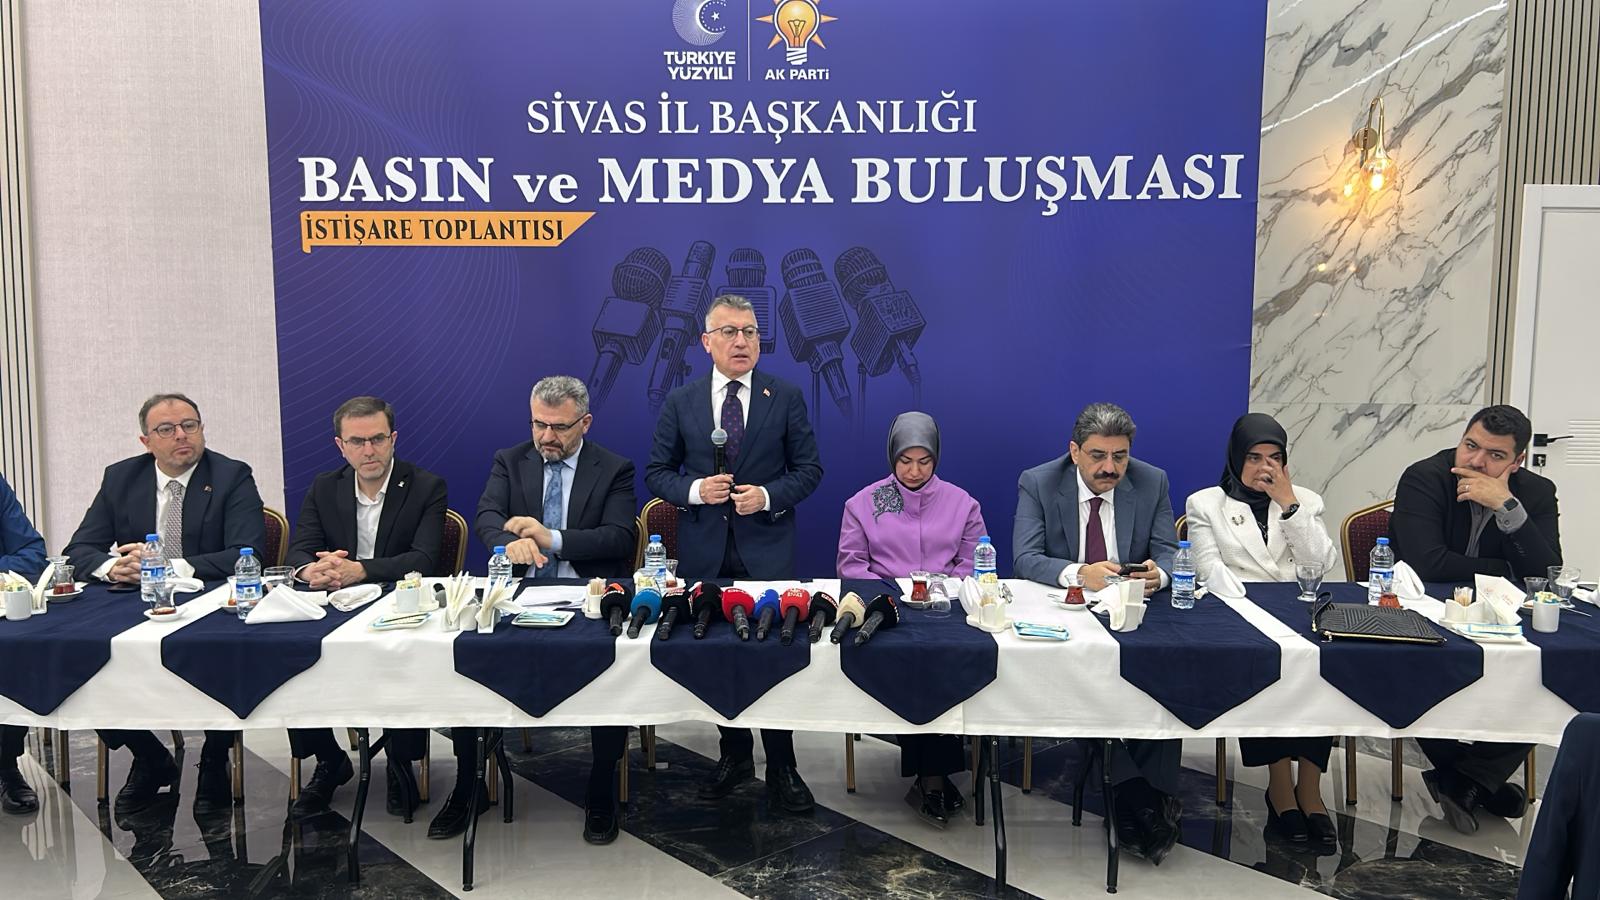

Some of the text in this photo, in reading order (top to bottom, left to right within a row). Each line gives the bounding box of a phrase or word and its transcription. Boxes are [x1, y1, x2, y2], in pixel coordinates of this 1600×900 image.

[664, 51, 736, 65] TÜRKİYE
[668, 66, 733, 80] YÜZYILI
[765, 69, 786, 80] AK
[527, 90, 978, 145] SİVAS İL BAŞKANLIĞI
[298, 154, 1245, 216] BASIN ve MEDYA BULUŞMASI
[306, 214, 564, 245] İSTİŞARE TOPLANTISI
